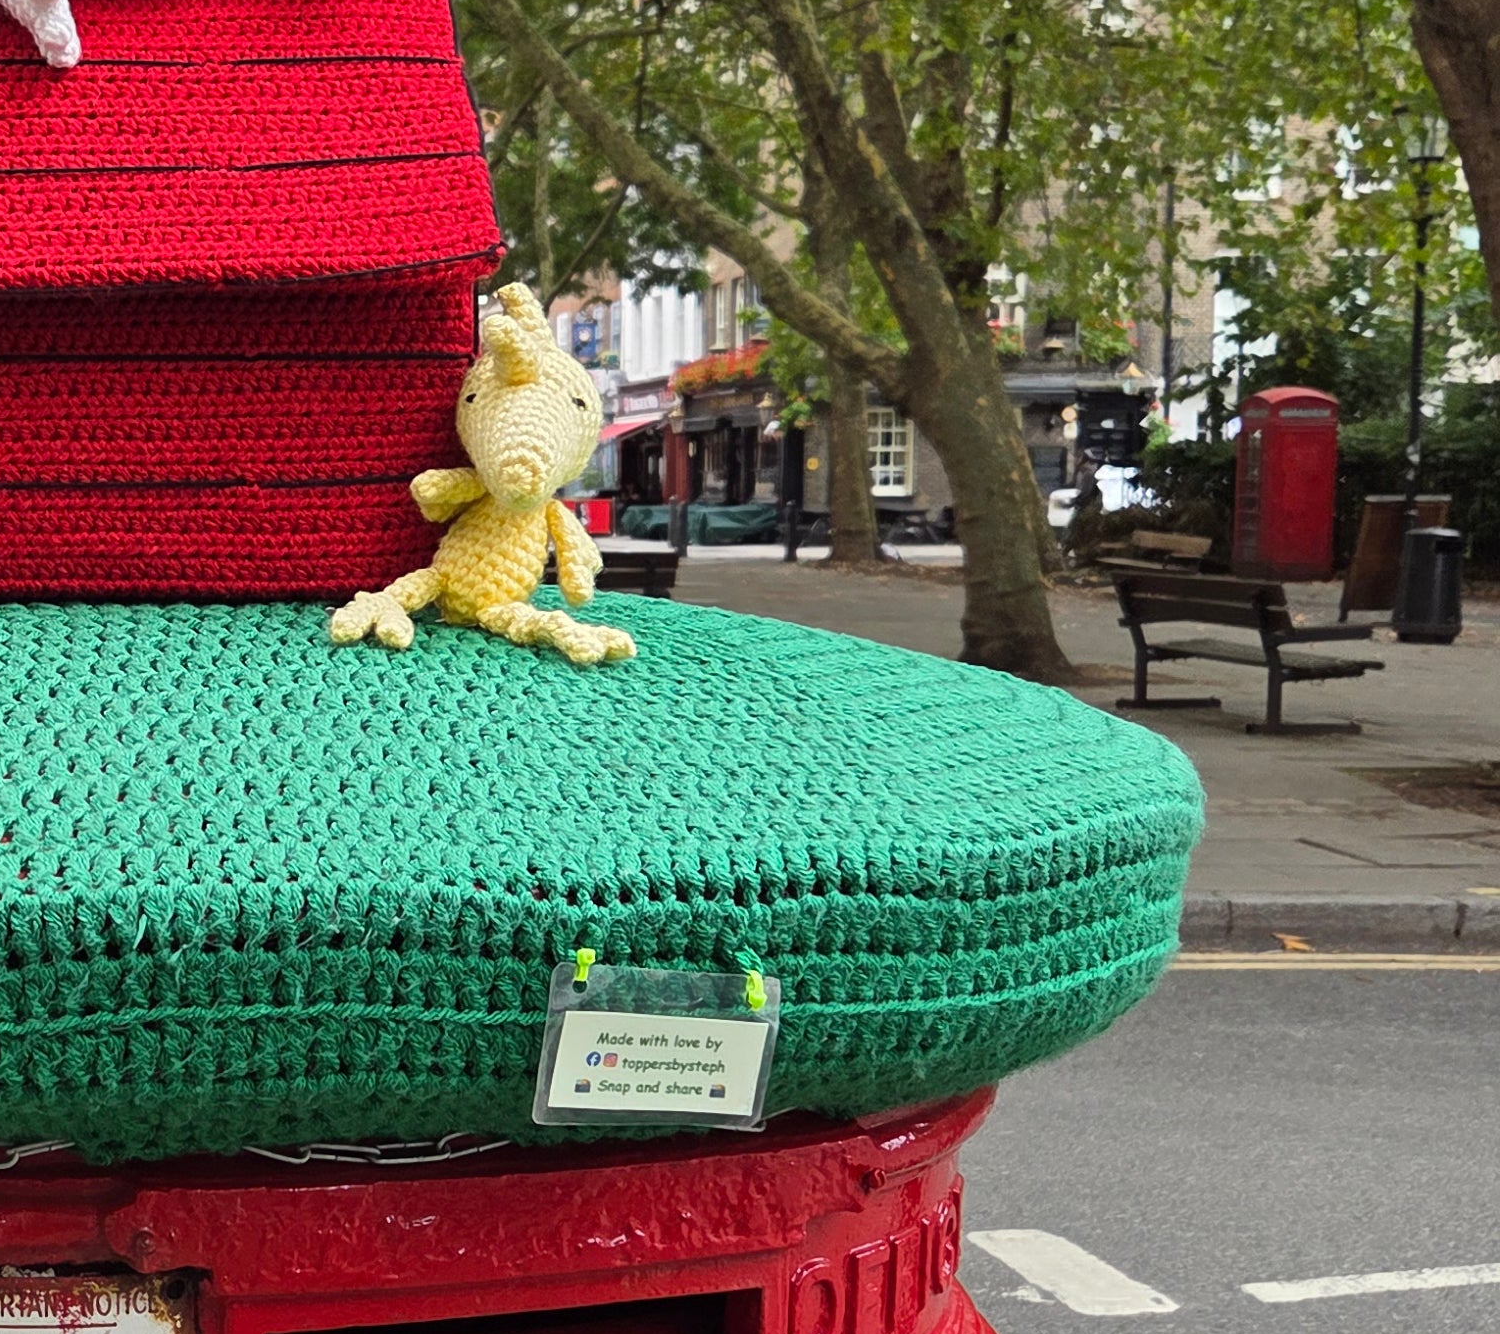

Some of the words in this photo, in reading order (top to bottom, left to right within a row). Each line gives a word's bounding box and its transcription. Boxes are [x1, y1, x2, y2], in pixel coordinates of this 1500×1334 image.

[597, 1033, 634, 1046] Made
[640, 1035, 669, 1048] with
[674, 1035, 700, 1048] love
[706, 1036, 723, 1052] by
[622, 1057, 725, 1074] toppersbysteph
[597, 1080, 630, 1094] Snap
[636, 1082, 660, 1094] and
[665, 1083, 703, 1096] share
